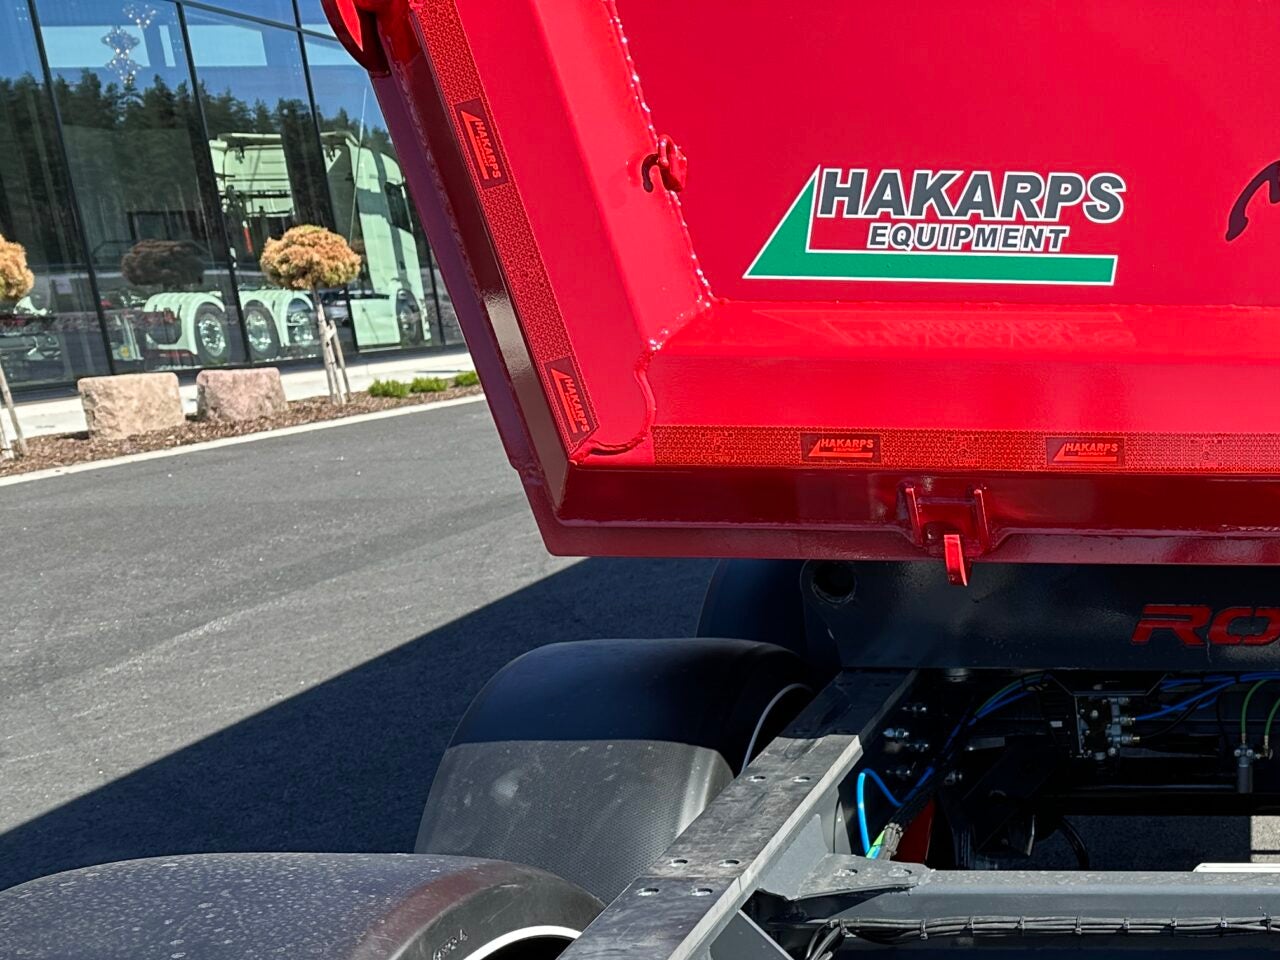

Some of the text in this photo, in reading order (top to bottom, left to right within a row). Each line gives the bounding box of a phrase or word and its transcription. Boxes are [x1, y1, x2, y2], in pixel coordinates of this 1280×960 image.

[474, 120, 502, 179] HAKARPS
[816, 167, 1128, 224] HAKARPS
[866, 222, 1070, 252] EQUIPMENT
[564, 378, 590, 432] HAKARPS
[820, 438, 874, 448] HAKARPS
[1065, 442, 1119, 452] HAKARPS
